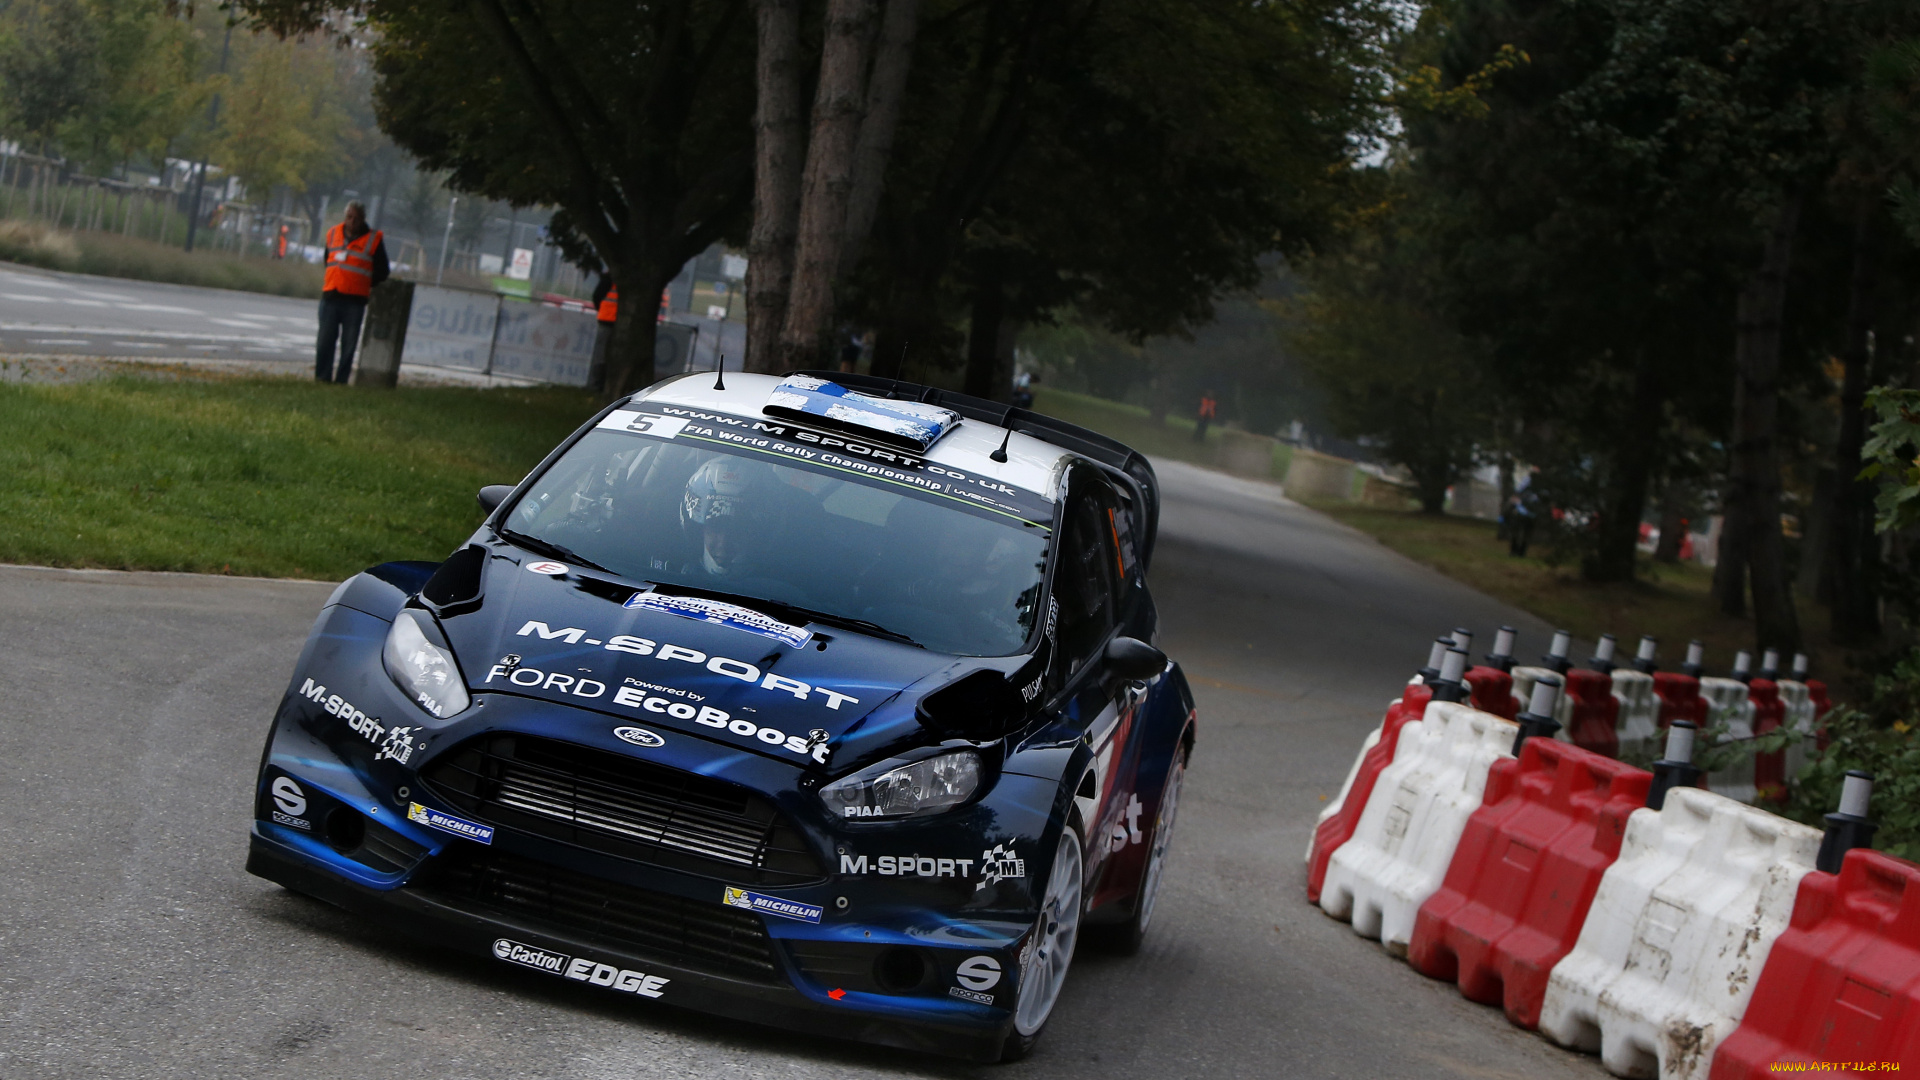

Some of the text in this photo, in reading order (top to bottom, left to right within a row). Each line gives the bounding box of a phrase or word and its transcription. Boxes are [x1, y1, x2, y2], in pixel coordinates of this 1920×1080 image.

[626, 414, 661, 432] 5
[684, 425, 714, 437] FIA
[719, 431, 769, 447] World
[772, 442, 817, 460] Rally
[821, 454, 942, 491] Championship
[534, 563, 561, 573] E
[704, 611, 730, 620] DE
[732, 611, 791, 631] Mutuel
[516, 620, 860, 711] M-SPORT
[485, 664, 607, 698] FORD
[624, 677, 706, 702] Powered by
[299, 677, 386, 744] M-SPORT
[417, 691, 443, 716] PIAA
[612, 685, 831, 764] EcoBoost
[624, 731, 653, 743] Ford
[844, 806, 884, 818] PIAA
[431, 814, 491, 838] MICHELIN
[840, 855, 974, 878] M-SPORT
[753, 897, 820, 919] MICHELIN
[510, 944, 565, 972] Castrol
[565, 957, 671, 998] EDGE
[951, 986, 993, 1002] sparco
